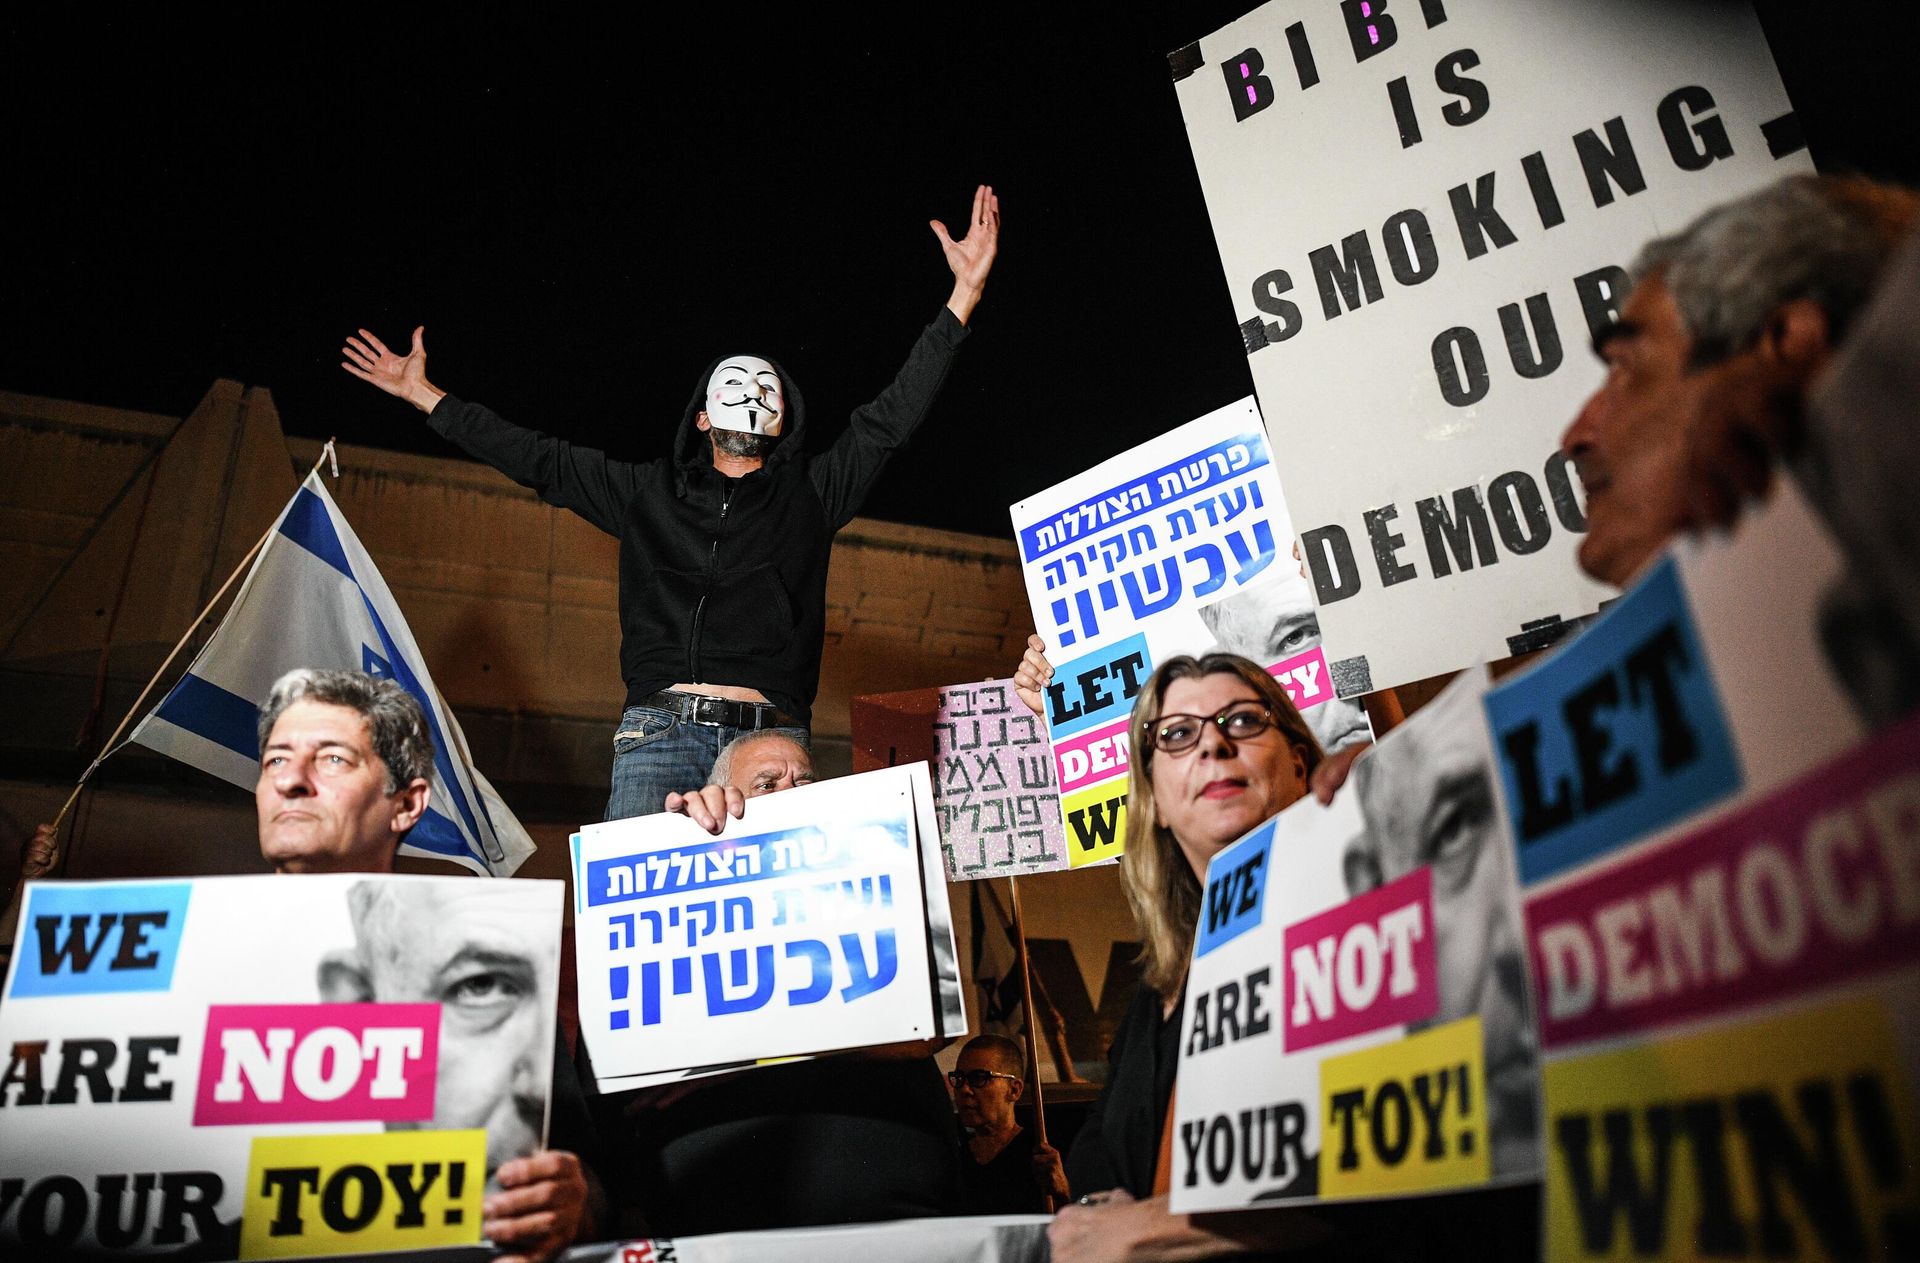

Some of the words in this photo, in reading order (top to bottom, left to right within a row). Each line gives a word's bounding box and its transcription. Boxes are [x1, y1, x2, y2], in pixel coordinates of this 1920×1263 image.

[1387, 48, 1490, 149] IS
[1251, 85, 1735, 342] SMOKING
[1159, 443, 1251, 500] פרשת
[1036, 482, 1152, 553] הצוללות
[1167, 480, 1264, 543] ועדת
[1043, 523, 1157, 590] חקירה
[1051, 519, 1276, 648] עכשיו!
[1048, 650, 1144, 727] LET
[1503, 620, 1700, 843] LET
[606, 843, 760, 897] הצוללות
[1206, 849, 1265, 935] WE
[34, 910, 170, 976] WE
[608, 896, 754, 950] חקירה
[609, 928, 899, 1031] עכשיו!
[1186, 966, 1271, 1057] ARE
[1291, 902, 1424, 1027] NOT
[0, 1036, 180, 1107] ARE
[213, 1026, 424, 1103] NOT
[1181, 1101, 1307, 1187] YOUR
[1330, 1061, 1473, 1171] TOY!
[260, 1161, 468, 1238] TOY!
